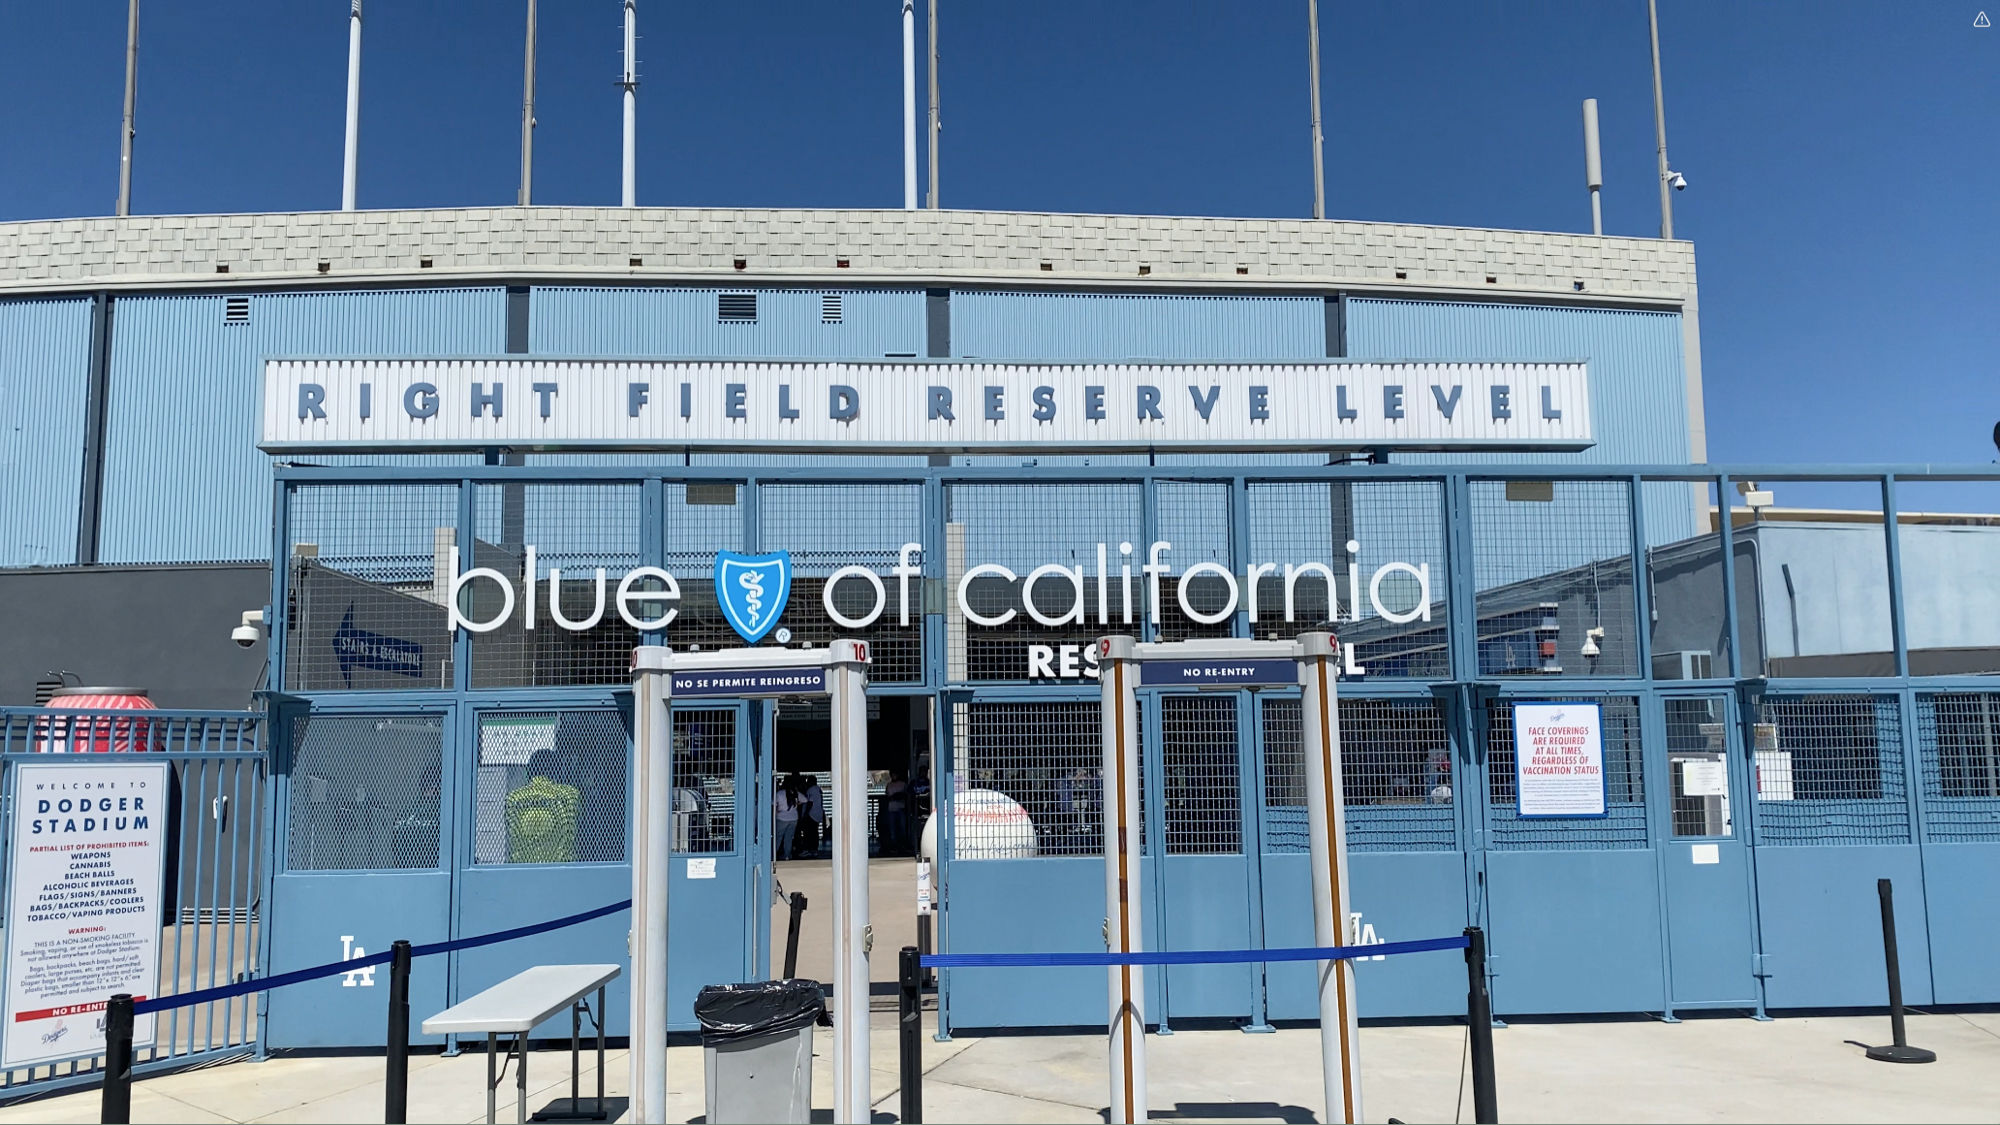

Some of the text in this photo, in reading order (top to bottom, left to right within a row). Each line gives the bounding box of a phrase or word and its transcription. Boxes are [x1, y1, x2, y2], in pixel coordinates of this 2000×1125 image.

[298, 382, 1562, 423] RIGHT FIELD RESERVE LEVEL
[447, 539, 1432, 632] blue of california
[1101, 640, 1110, 657] 9
[1330, 635, 1337, 653] 9
[342, 637, 369, 656] STAIRS
[381, 645, 420, 666] ESCALATORS
[854, 644, 866, 661] 10
[1184, 668, 1255, 676] NO RE-ENTRY
[676, 676, 821, 689] NO SE PERMITE REINGRESO
[1528, 727, 1589, 735] FACE COVERINGS
[1533, 737, 1585, 745] ARE REQUIRED
[1536, 747, 1583, 755] AT ALL TIMES,
[1532, 756, 1589, 765] REGARDLESS OF
[1523, 766, 1599, 775] VACCINATION STATUS
[37, 782, 115, 790] WELCOME
[39, 798, 144, 813] DODGER
[32, 816, 148, 834] STADIUM
[87, 842, 127, 850] PROHIBITED
[71, 851, 111, 860] WEAPONS
[70, 861, 111, 870] CANNABIS
[65, 872, 90, 880] BEACH
[43, 879, 134, 891] ALCOHOLIC BEVERAGES
[40, 888, 137, 901] FLAGS/SIGNS/BANNERS
[30, 897, 144, 912] BAGS/BACKPACKS/COOLERS
[27, 906, 145, 922] TOBACCO/VAPING PRODUCTS
[68, 926, 106, 935] WARNING:
[62, 951, 87, 959] anywhere
[116, 961, 141, 970] permitted
[41, 990, 67, 999] permitted
[71, 1002, 108, 1013] RE-ENTR
[42, 1027, 68, 1044] Dodgers
